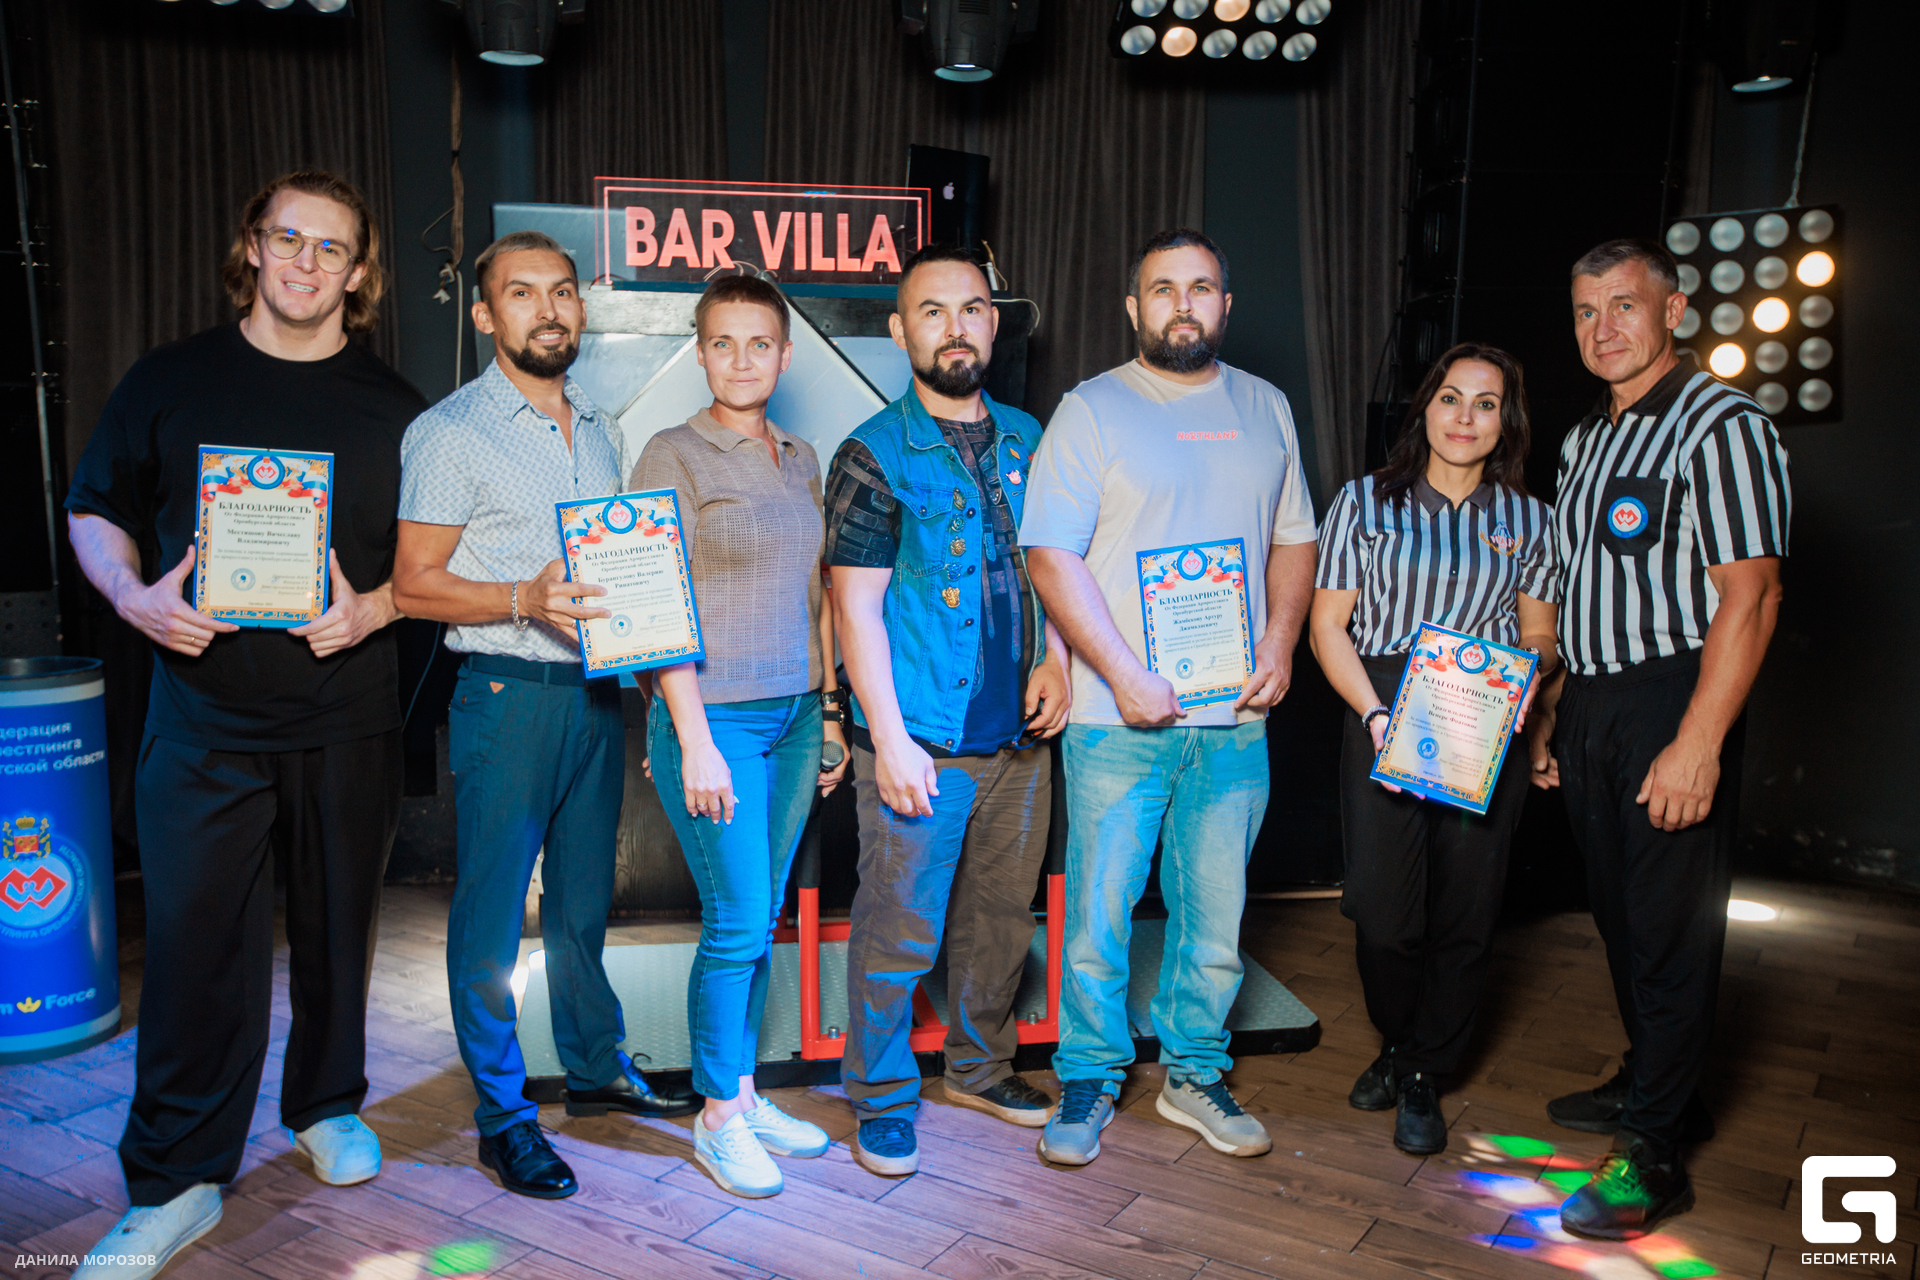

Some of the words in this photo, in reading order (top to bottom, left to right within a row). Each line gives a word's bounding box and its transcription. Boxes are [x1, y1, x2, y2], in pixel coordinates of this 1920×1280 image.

[625, 206, 735, 269] BAR
[752, 210, 902, 273] VILLA
[1177, 430, 1238, 441] NORTHLAND
[219, 502, 312, 514] БЛАГОДАРНОСТЬ
[1490, 535, 1515, 548] WAF
[585, 543, 668, 561] БЛАГОДАРНОСТЬ
[1159, 588, 1233, 605] БЛАГОДАРНОСТЬ
[1422, 675, 1504, 705] БЛАГОДАРНОСТЬ
[45, 987, 97, 1011] Force
